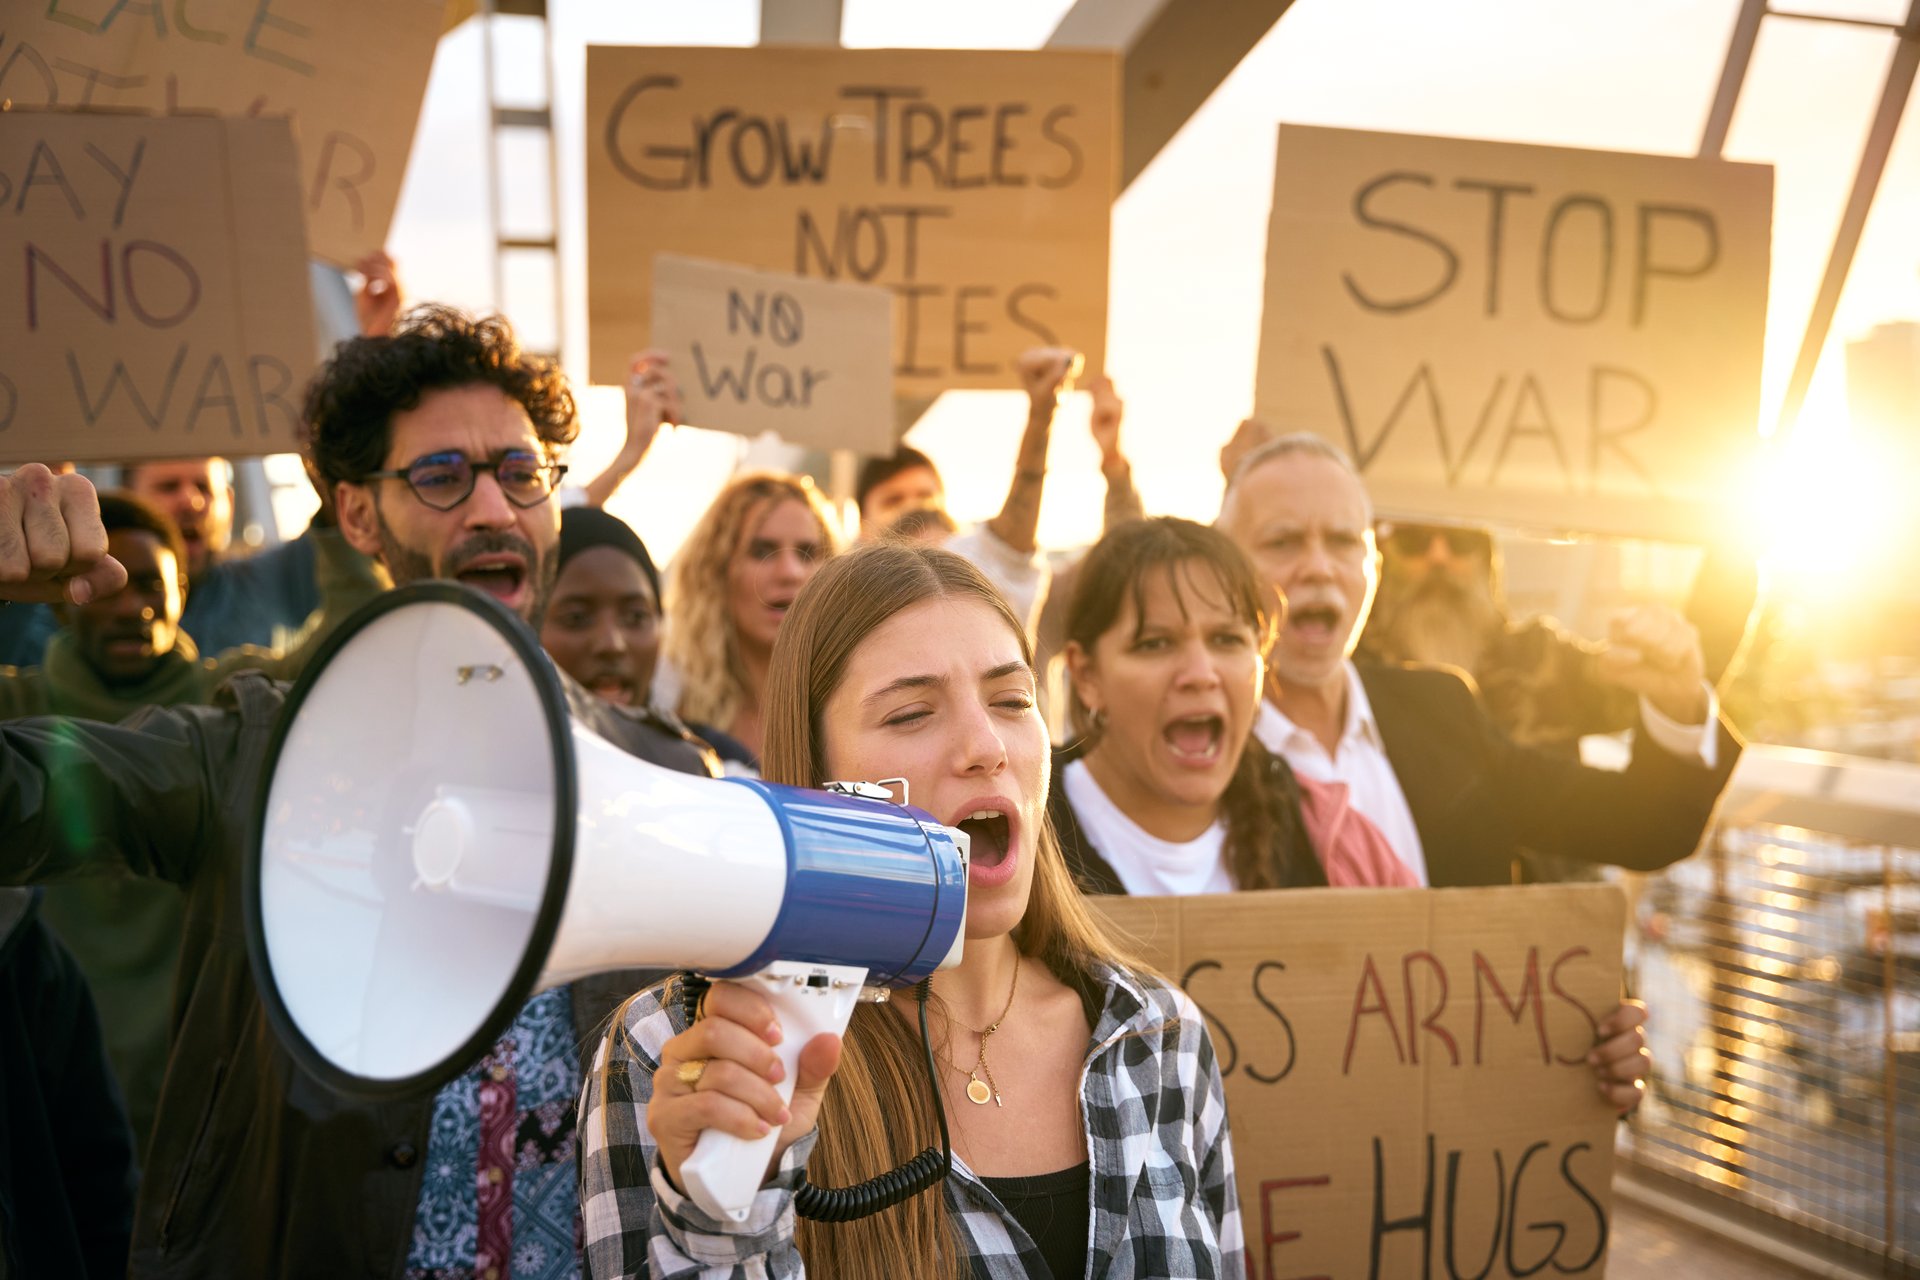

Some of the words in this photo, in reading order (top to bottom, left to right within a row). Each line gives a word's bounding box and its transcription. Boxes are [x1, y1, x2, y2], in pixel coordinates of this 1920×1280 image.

[0, 138, 147, 228] AY
[838, 86, 1085, 191] TREES
[26, 238, 201, 332] NO
[794, 204, 953, 284] NOT
[1341, 168, 1723, 331] STOP
[691, 341, 832, 410] War
[883, 282, 1062, 378] IES
[65, 342, 301, 438] WAR
[1321, 341, 1660, 495] WAR
[1181, 960, 1295, 1083] SS
[1342, 946, 1599, 1075] ARMS
[1368, 1132, 1610, 1280] HUGS
